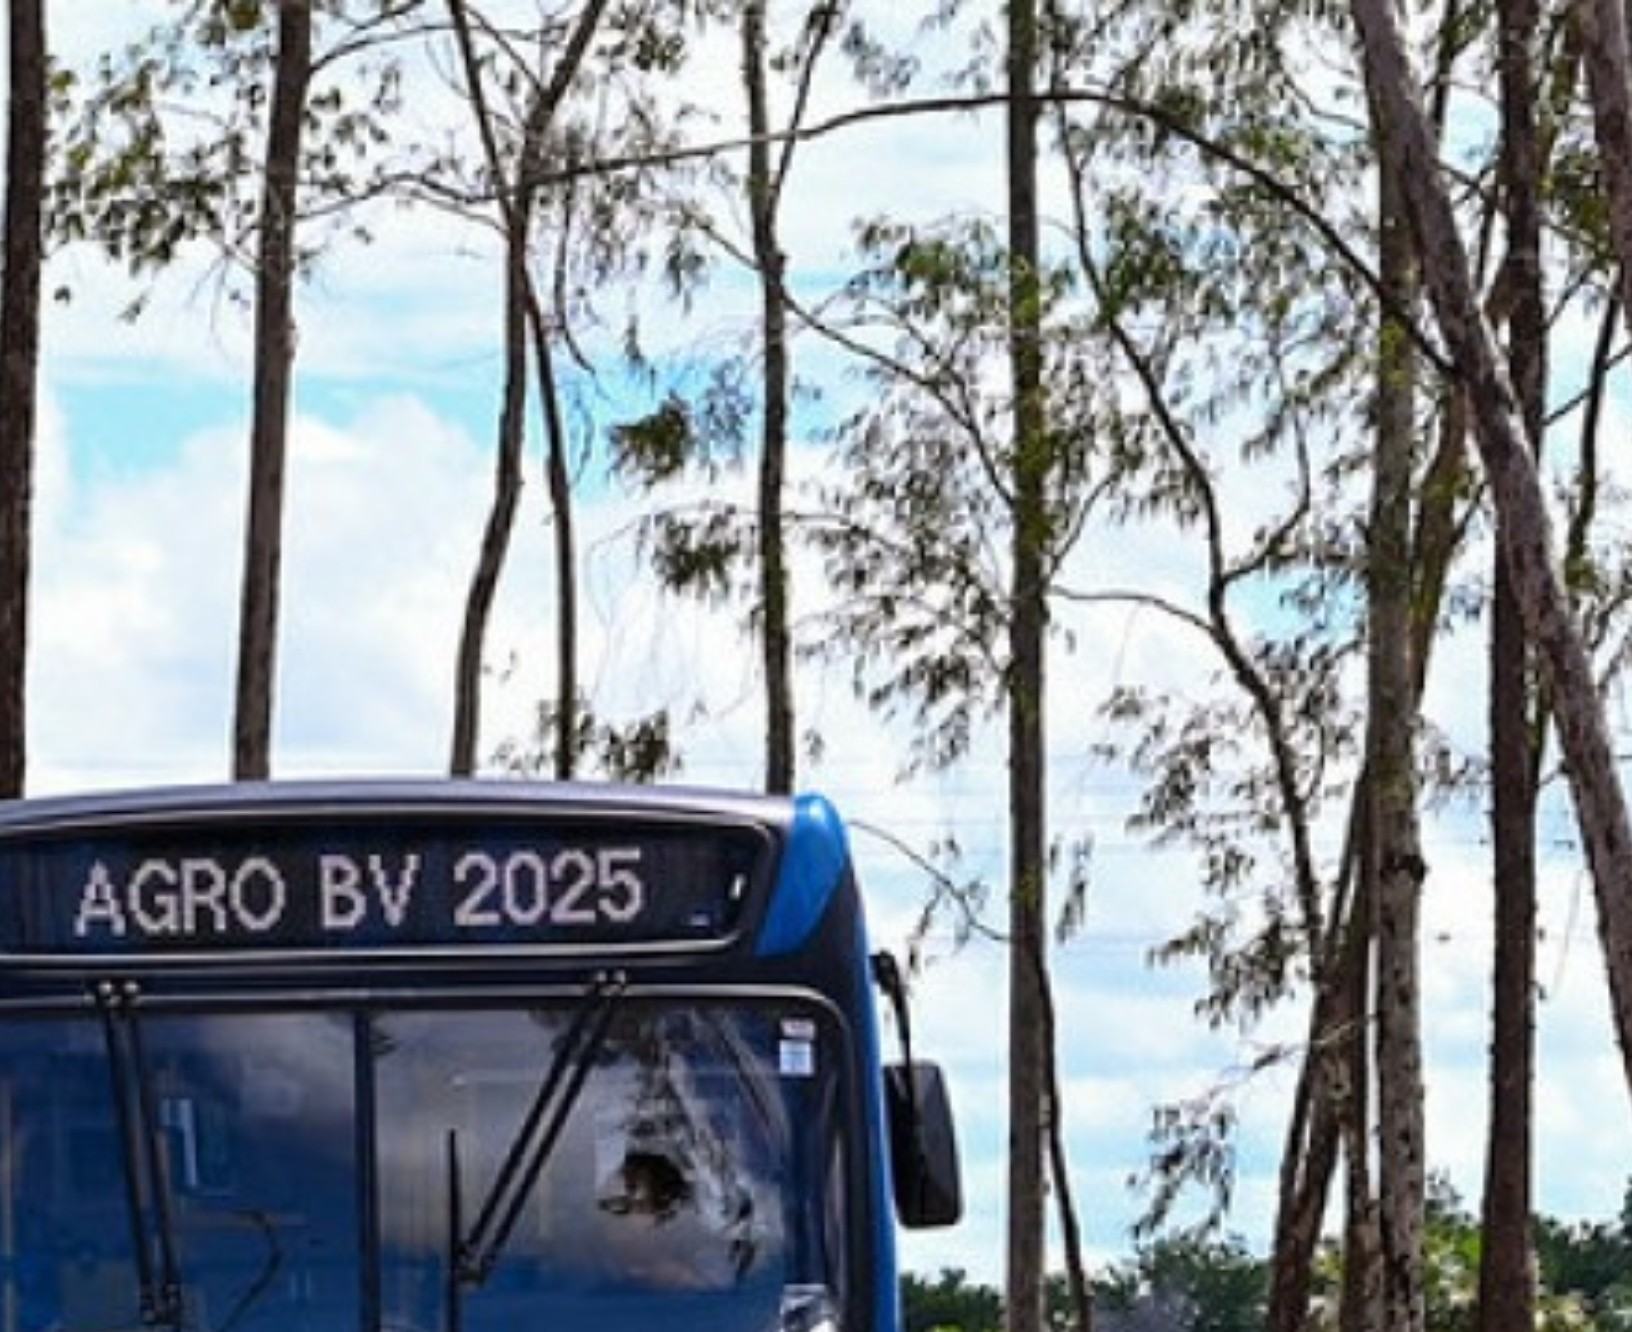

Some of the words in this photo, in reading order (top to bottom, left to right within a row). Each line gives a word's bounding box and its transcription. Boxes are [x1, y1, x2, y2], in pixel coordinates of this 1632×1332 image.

[74, 857, 286, 937] AGRO
[319, 854, 420, 929] BV
[452, 847, 643, 926] 2025
